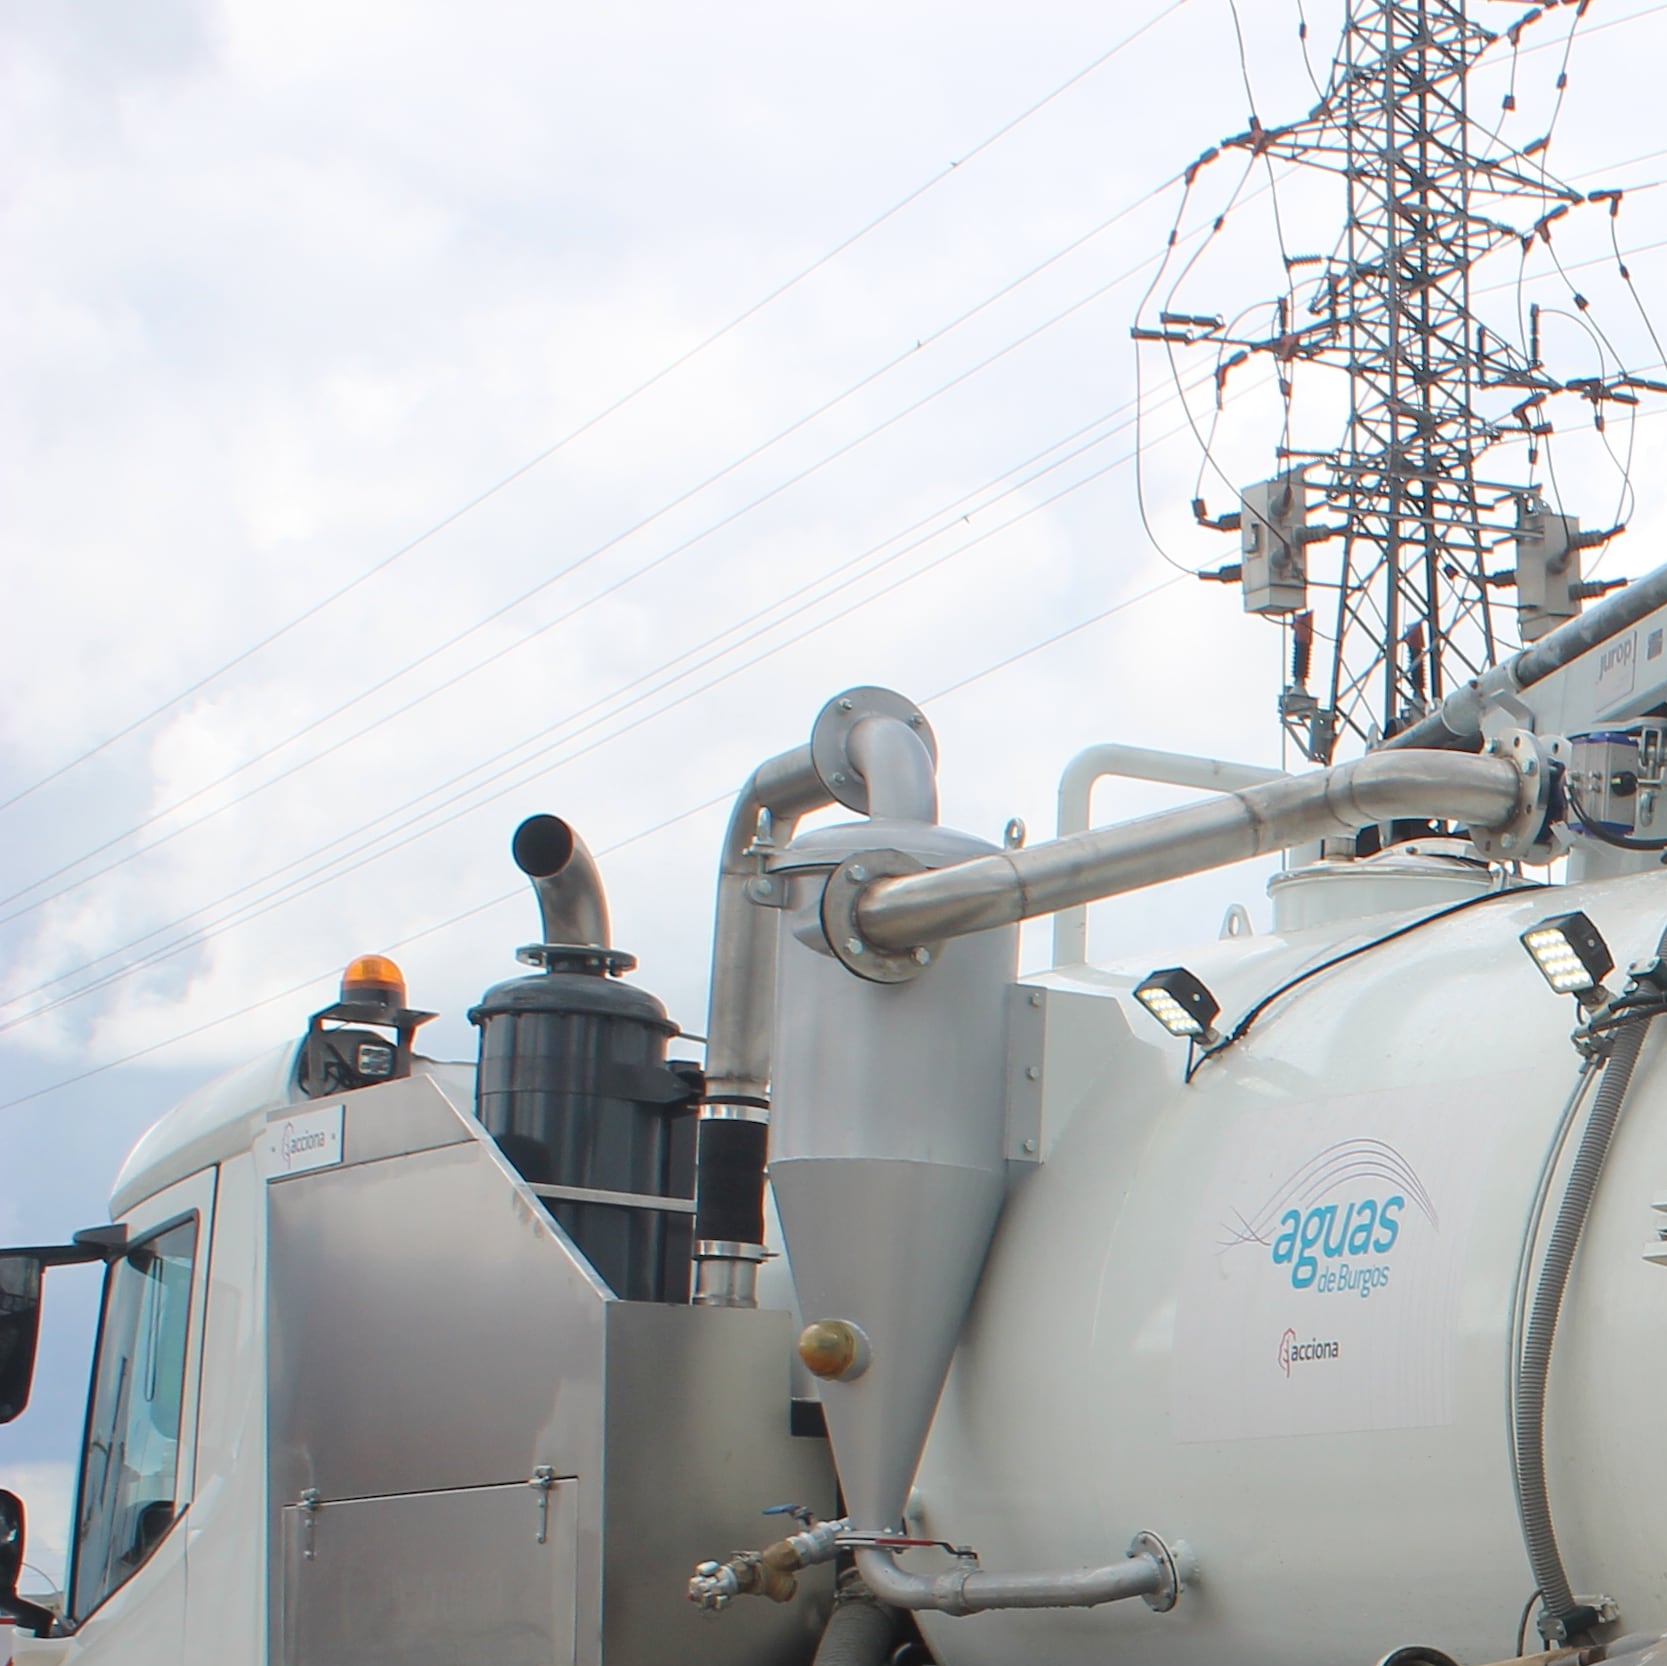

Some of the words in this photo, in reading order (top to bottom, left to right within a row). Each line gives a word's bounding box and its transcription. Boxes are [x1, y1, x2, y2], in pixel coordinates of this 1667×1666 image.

[290, 1129, 326, 1155] acciona
[1272, 1195, 1405, 1289] aguas
[1317, 1265, 1336, 1293] de
[1337, 1263, 1391, 1299] Burgos
[1291, 1337, 1340, 1362] acciona
